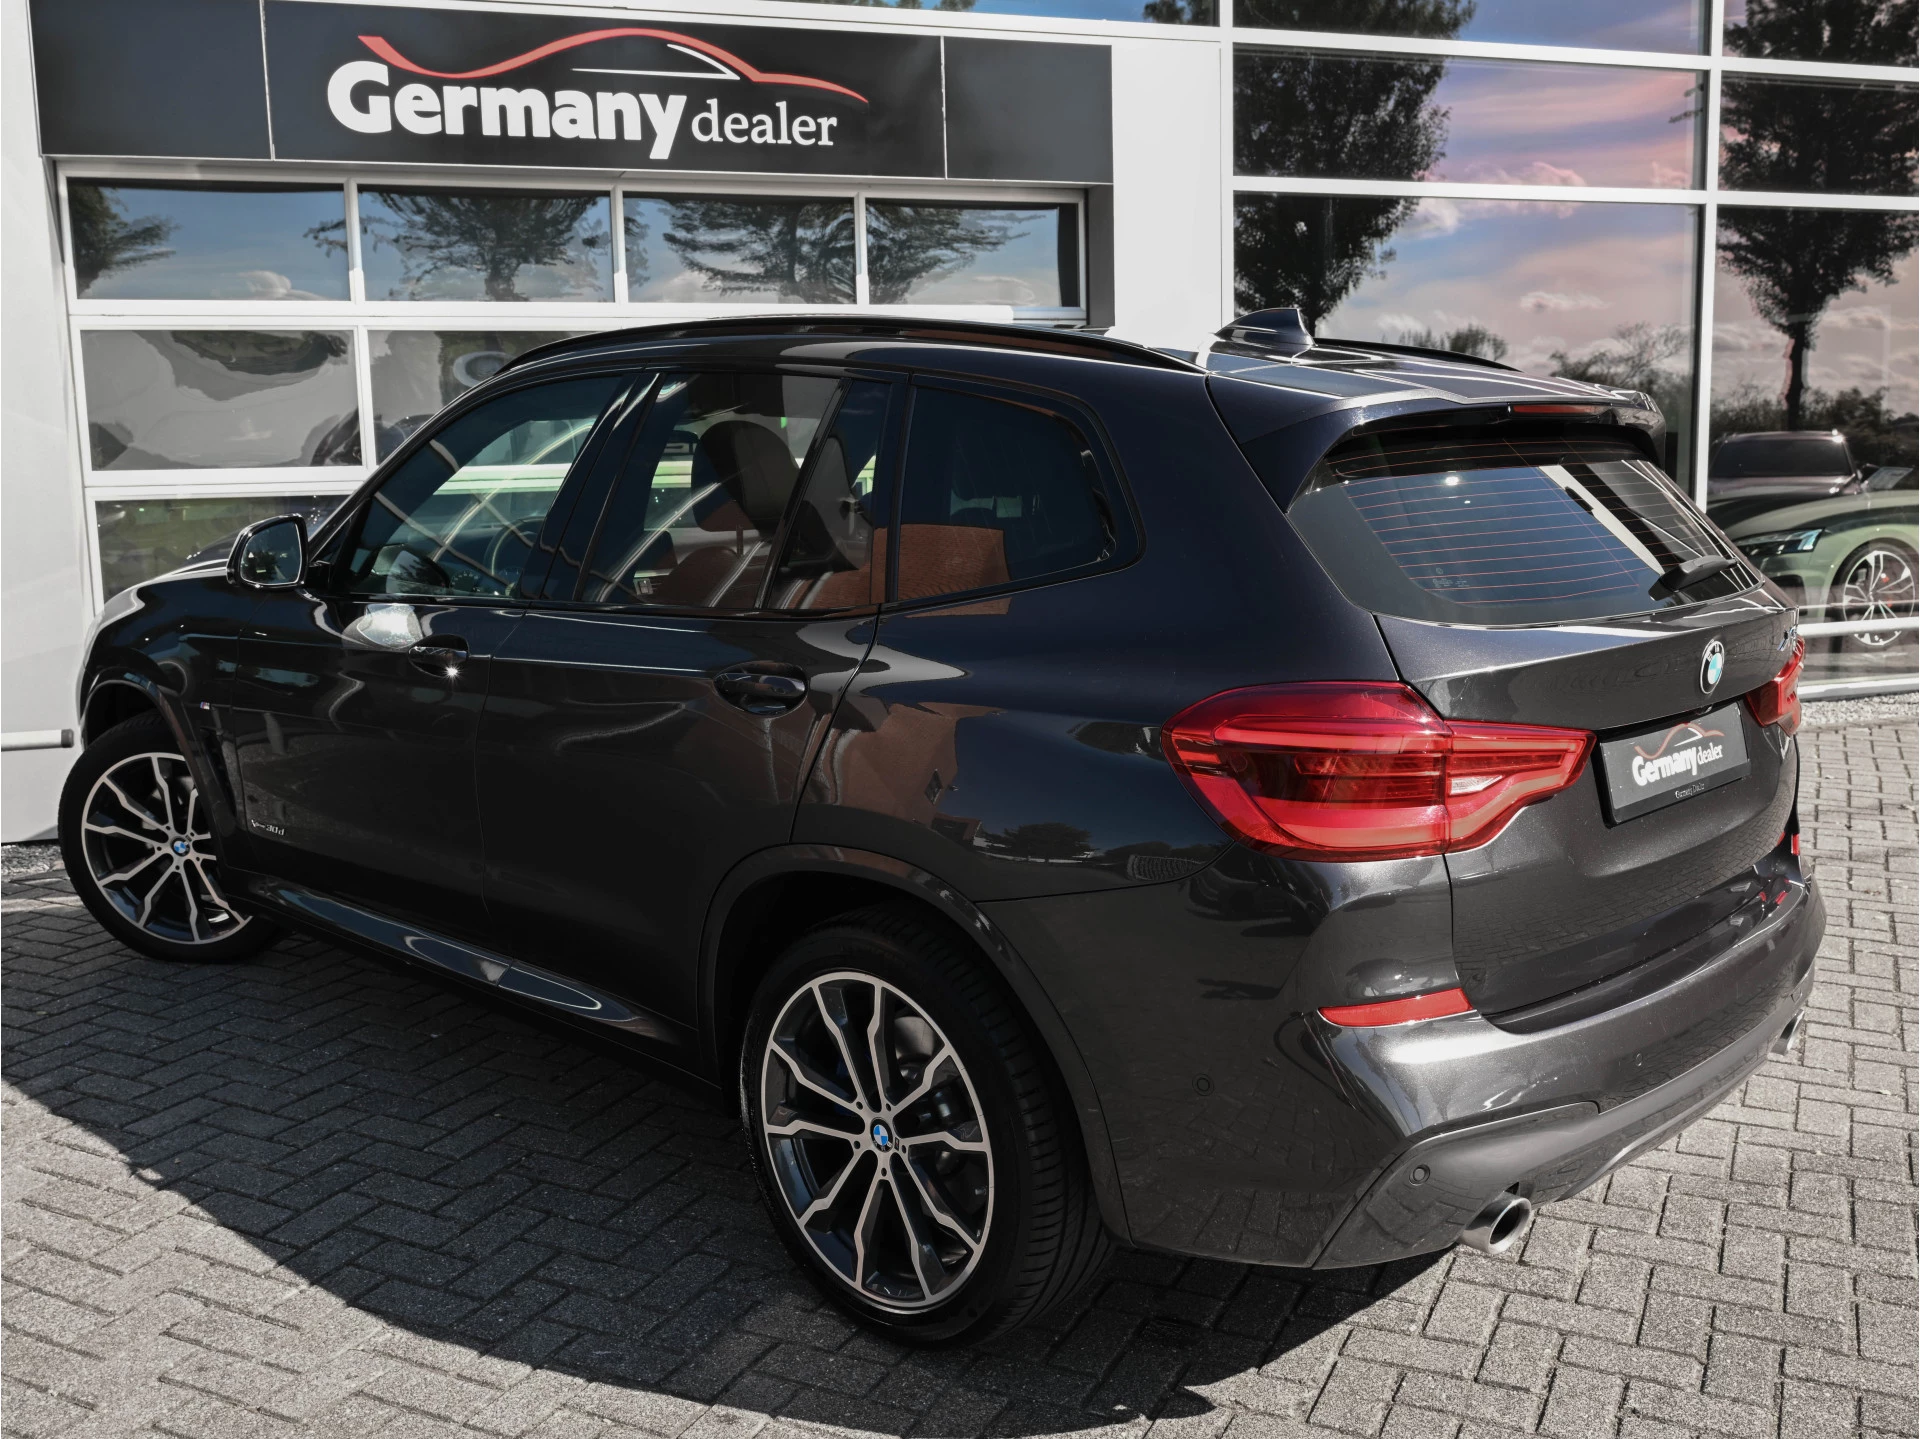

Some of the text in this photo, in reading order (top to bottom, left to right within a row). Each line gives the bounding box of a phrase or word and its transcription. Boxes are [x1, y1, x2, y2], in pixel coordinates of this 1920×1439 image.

[327, 60, 837, 159] Germany dealer
[1632, 742, 1723, 786] Germany dealer
